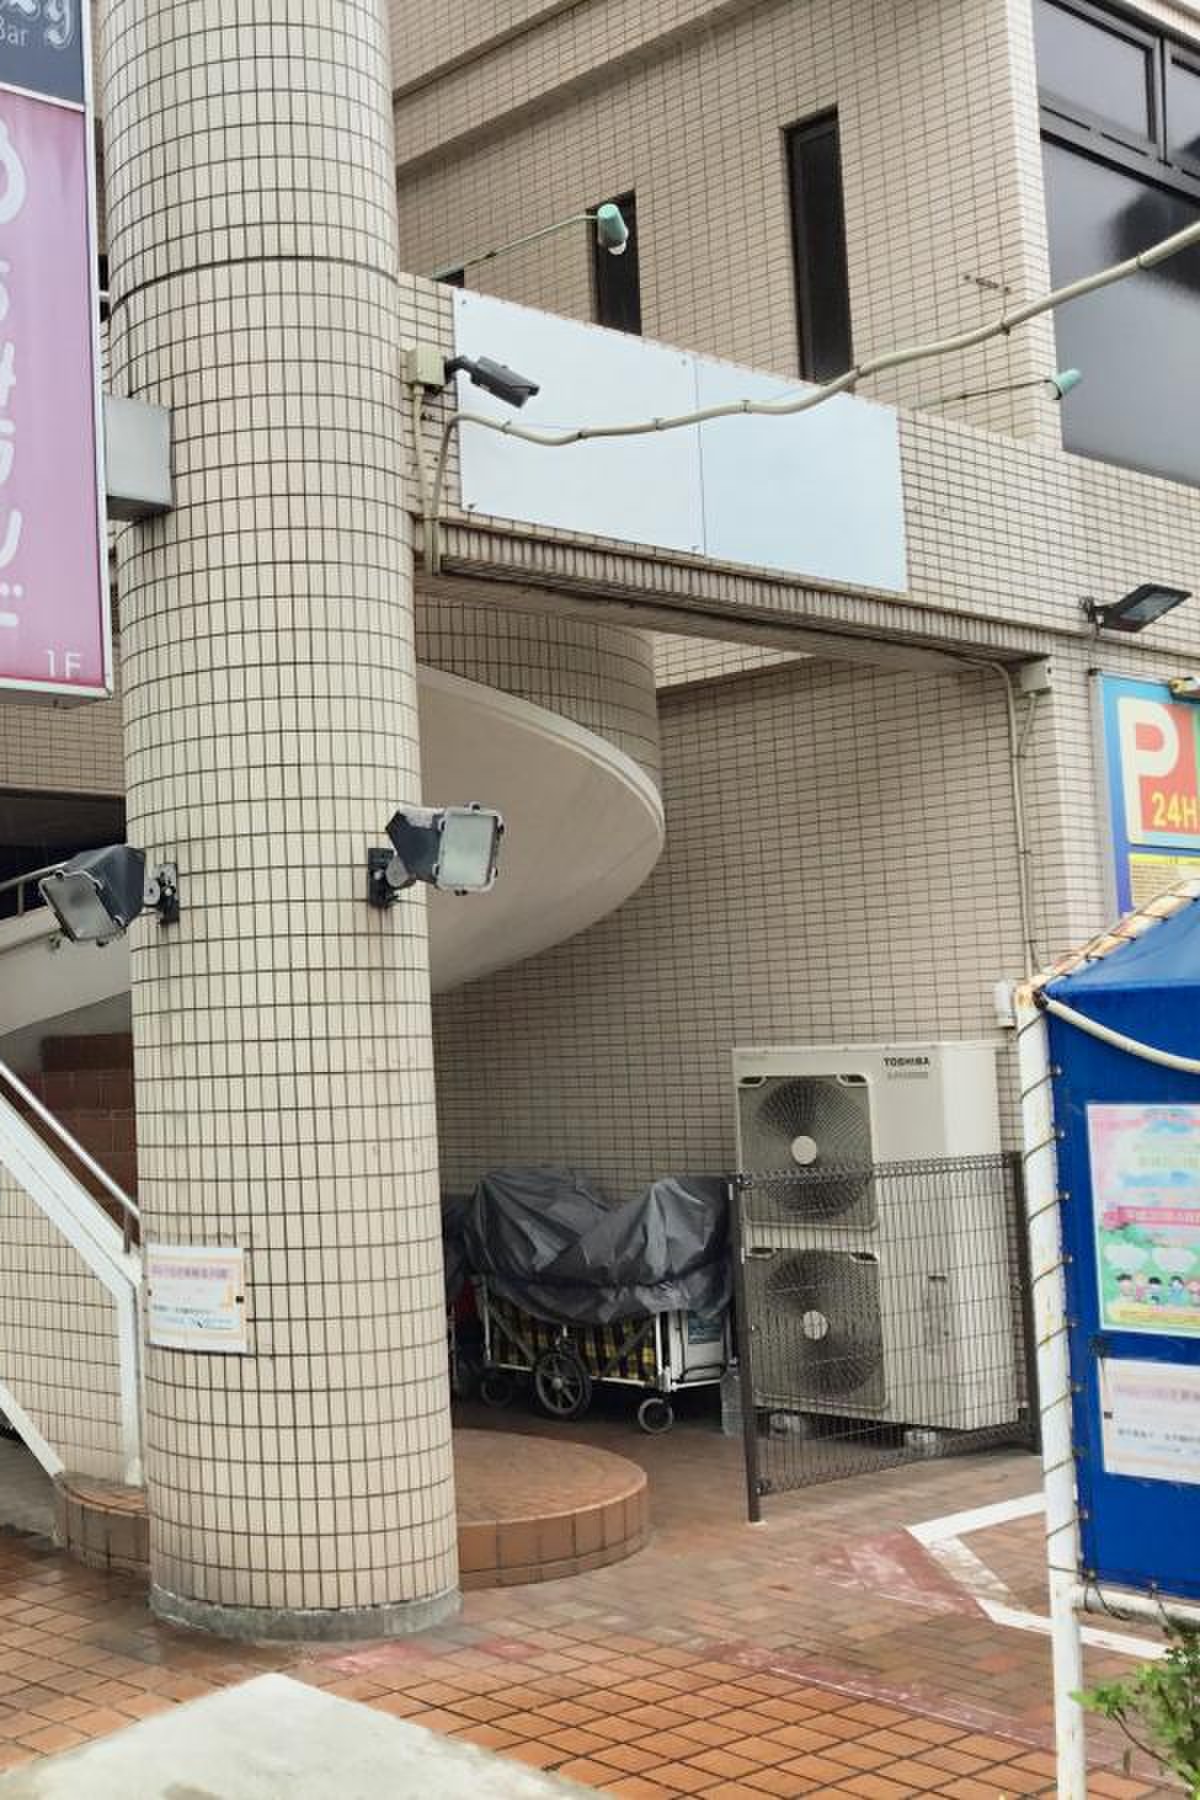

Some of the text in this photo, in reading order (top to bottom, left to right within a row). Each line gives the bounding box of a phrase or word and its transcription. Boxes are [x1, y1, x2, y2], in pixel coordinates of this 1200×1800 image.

[46, 650, 81, 679] 1F
[1117, 697, 1178, 841] P
[1151, 791, 1198, 829] 24H
